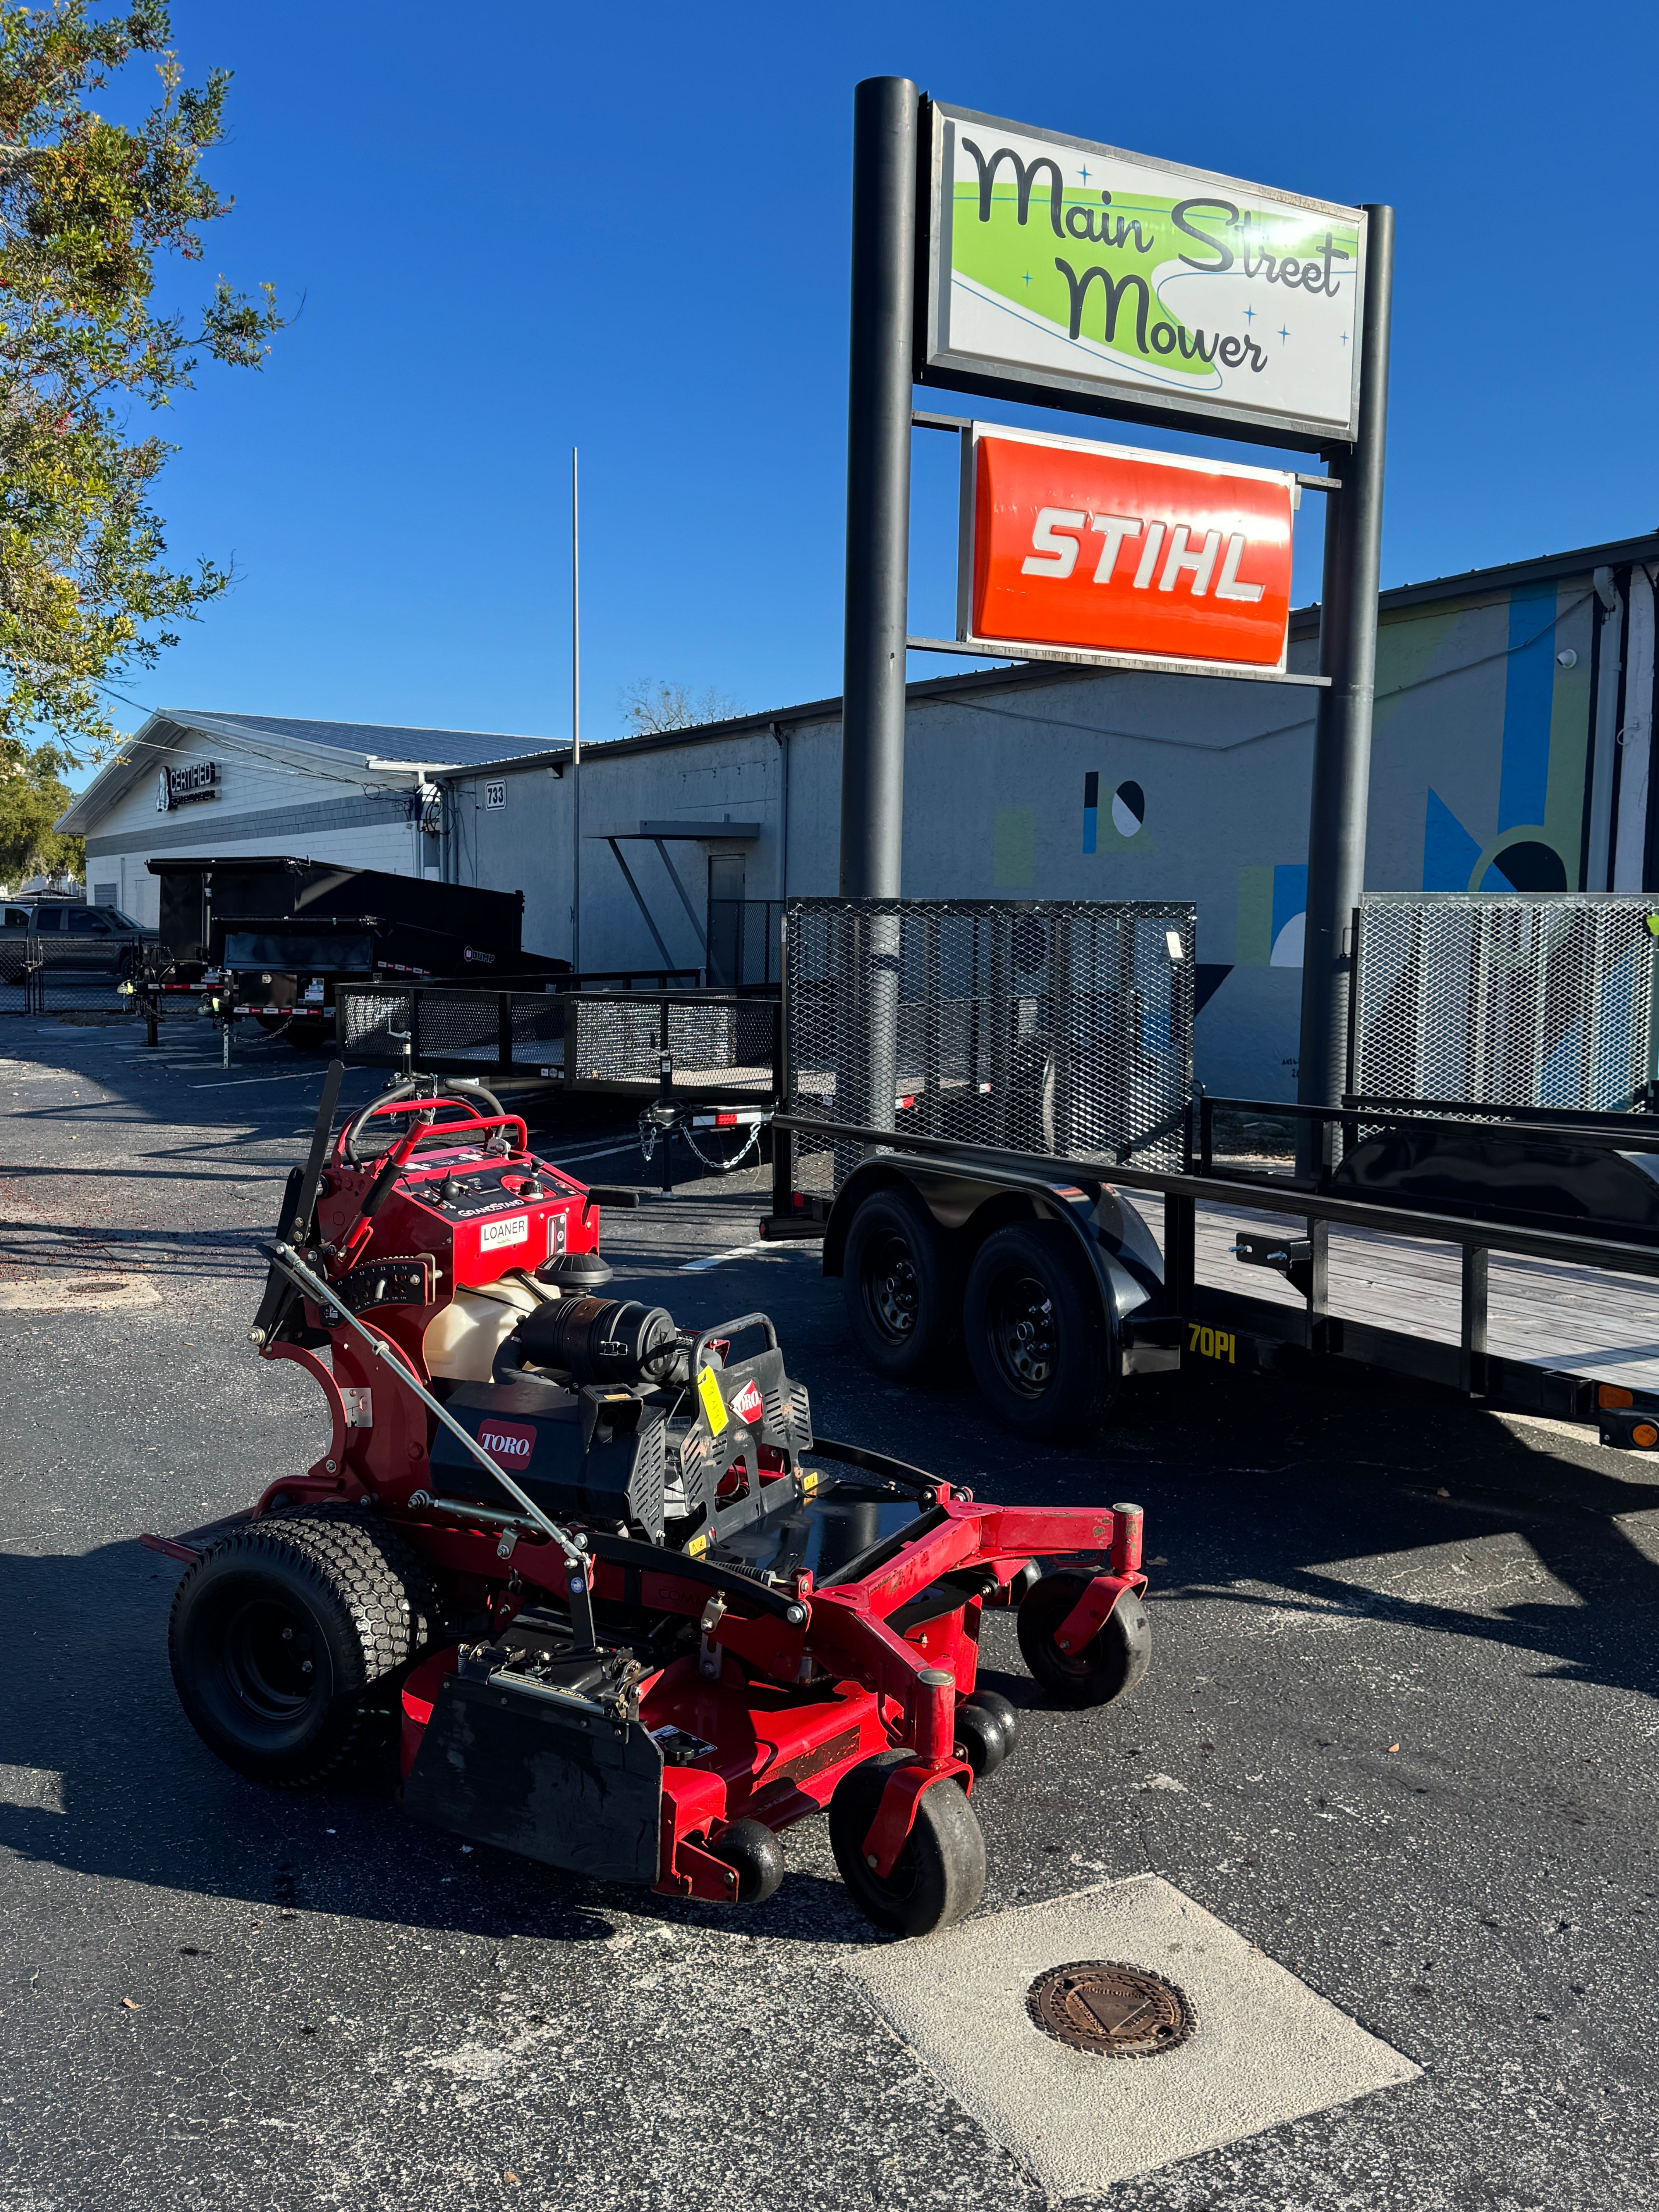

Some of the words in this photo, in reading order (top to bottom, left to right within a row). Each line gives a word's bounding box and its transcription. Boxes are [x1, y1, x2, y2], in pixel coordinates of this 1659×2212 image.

[962, 136, 1154, 254] Main
[1171, 197, 1349, 297] Street
[1055, 256, 1267, 373] Mower
[1020, 505, 1266, 602] STIHL
[170, 762, 211, 792] CERTIFIED
[488, 787, 503, 804] 733
[484, 1220, 525, 1241] LOANER
[1188, 1322, 1235, 1364] 70PI
[737, 1390, 759, 1413] ORO
[481, 1433, 530, 1456] TORO
[1084, 1986, 1146, 2000] MONITORING
